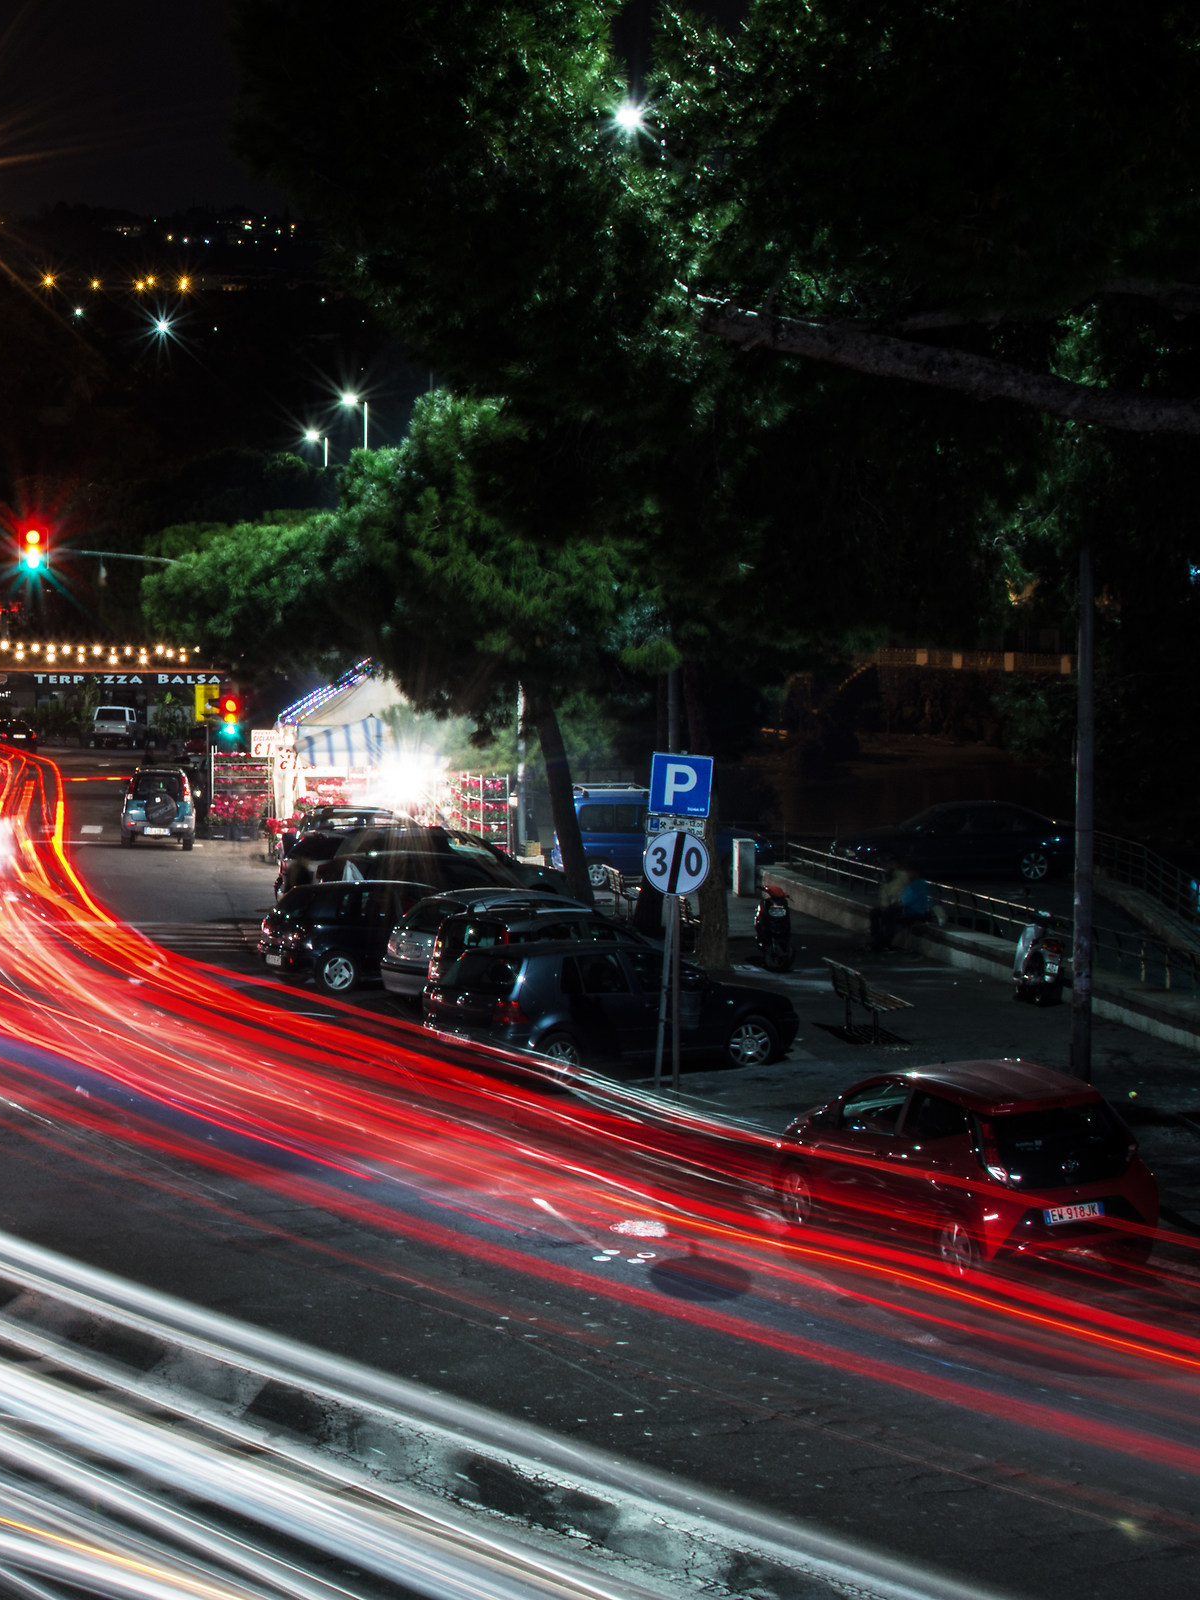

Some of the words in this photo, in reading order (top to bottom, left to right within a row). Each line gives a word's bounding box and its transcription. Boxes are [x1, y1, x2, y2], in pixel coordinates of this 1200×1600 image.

[34, 673, 143, 685] TERRZZA
[157, 673, 232, 685] BALSA
[664, 763, 697, 806] P
